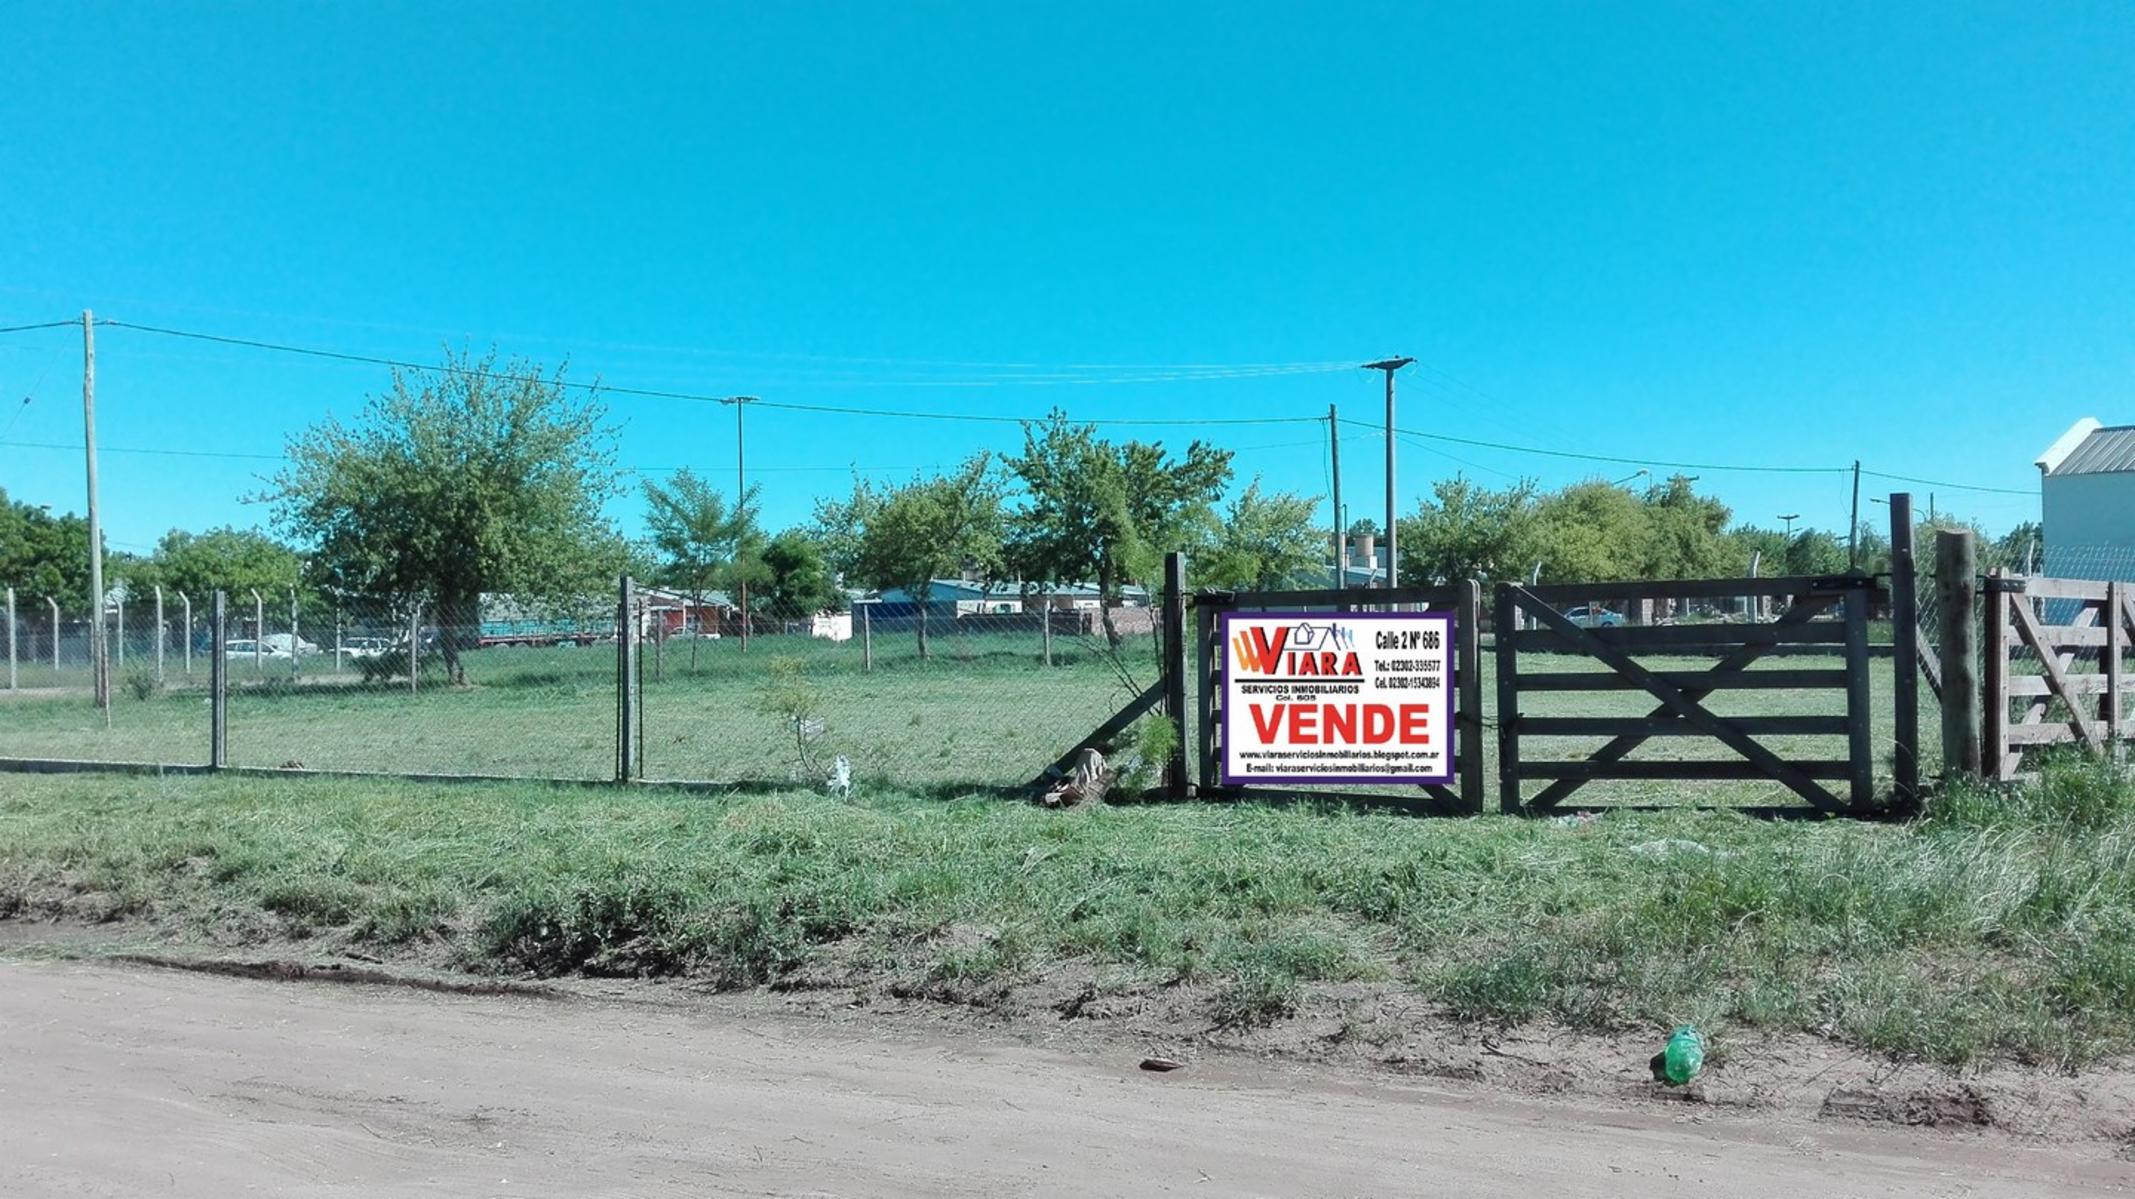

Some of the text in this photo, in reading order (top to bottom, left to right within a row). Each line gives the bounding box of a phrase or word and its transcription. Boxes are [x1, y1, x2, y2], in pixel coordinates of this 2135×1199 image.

[1375, 630, 1399, 650] Calle
[1401, 630, 1408, 650] 2
[1422, 630, 1440, 650] 686
[1250, 626, 1363, 676] VIARA
[1241, 685, 1359, 695] SERVICIOS INMOBILIARIOS
[1249, 703, 1430, 745] VENDE
[1239, 750, 1440, 761] www.viaraserviciosinmobiliarios.blogspot.com.ar
[1246, 762, 1433, 774] E-mail: viaraserviciosinmobiliarios@gmail.com
